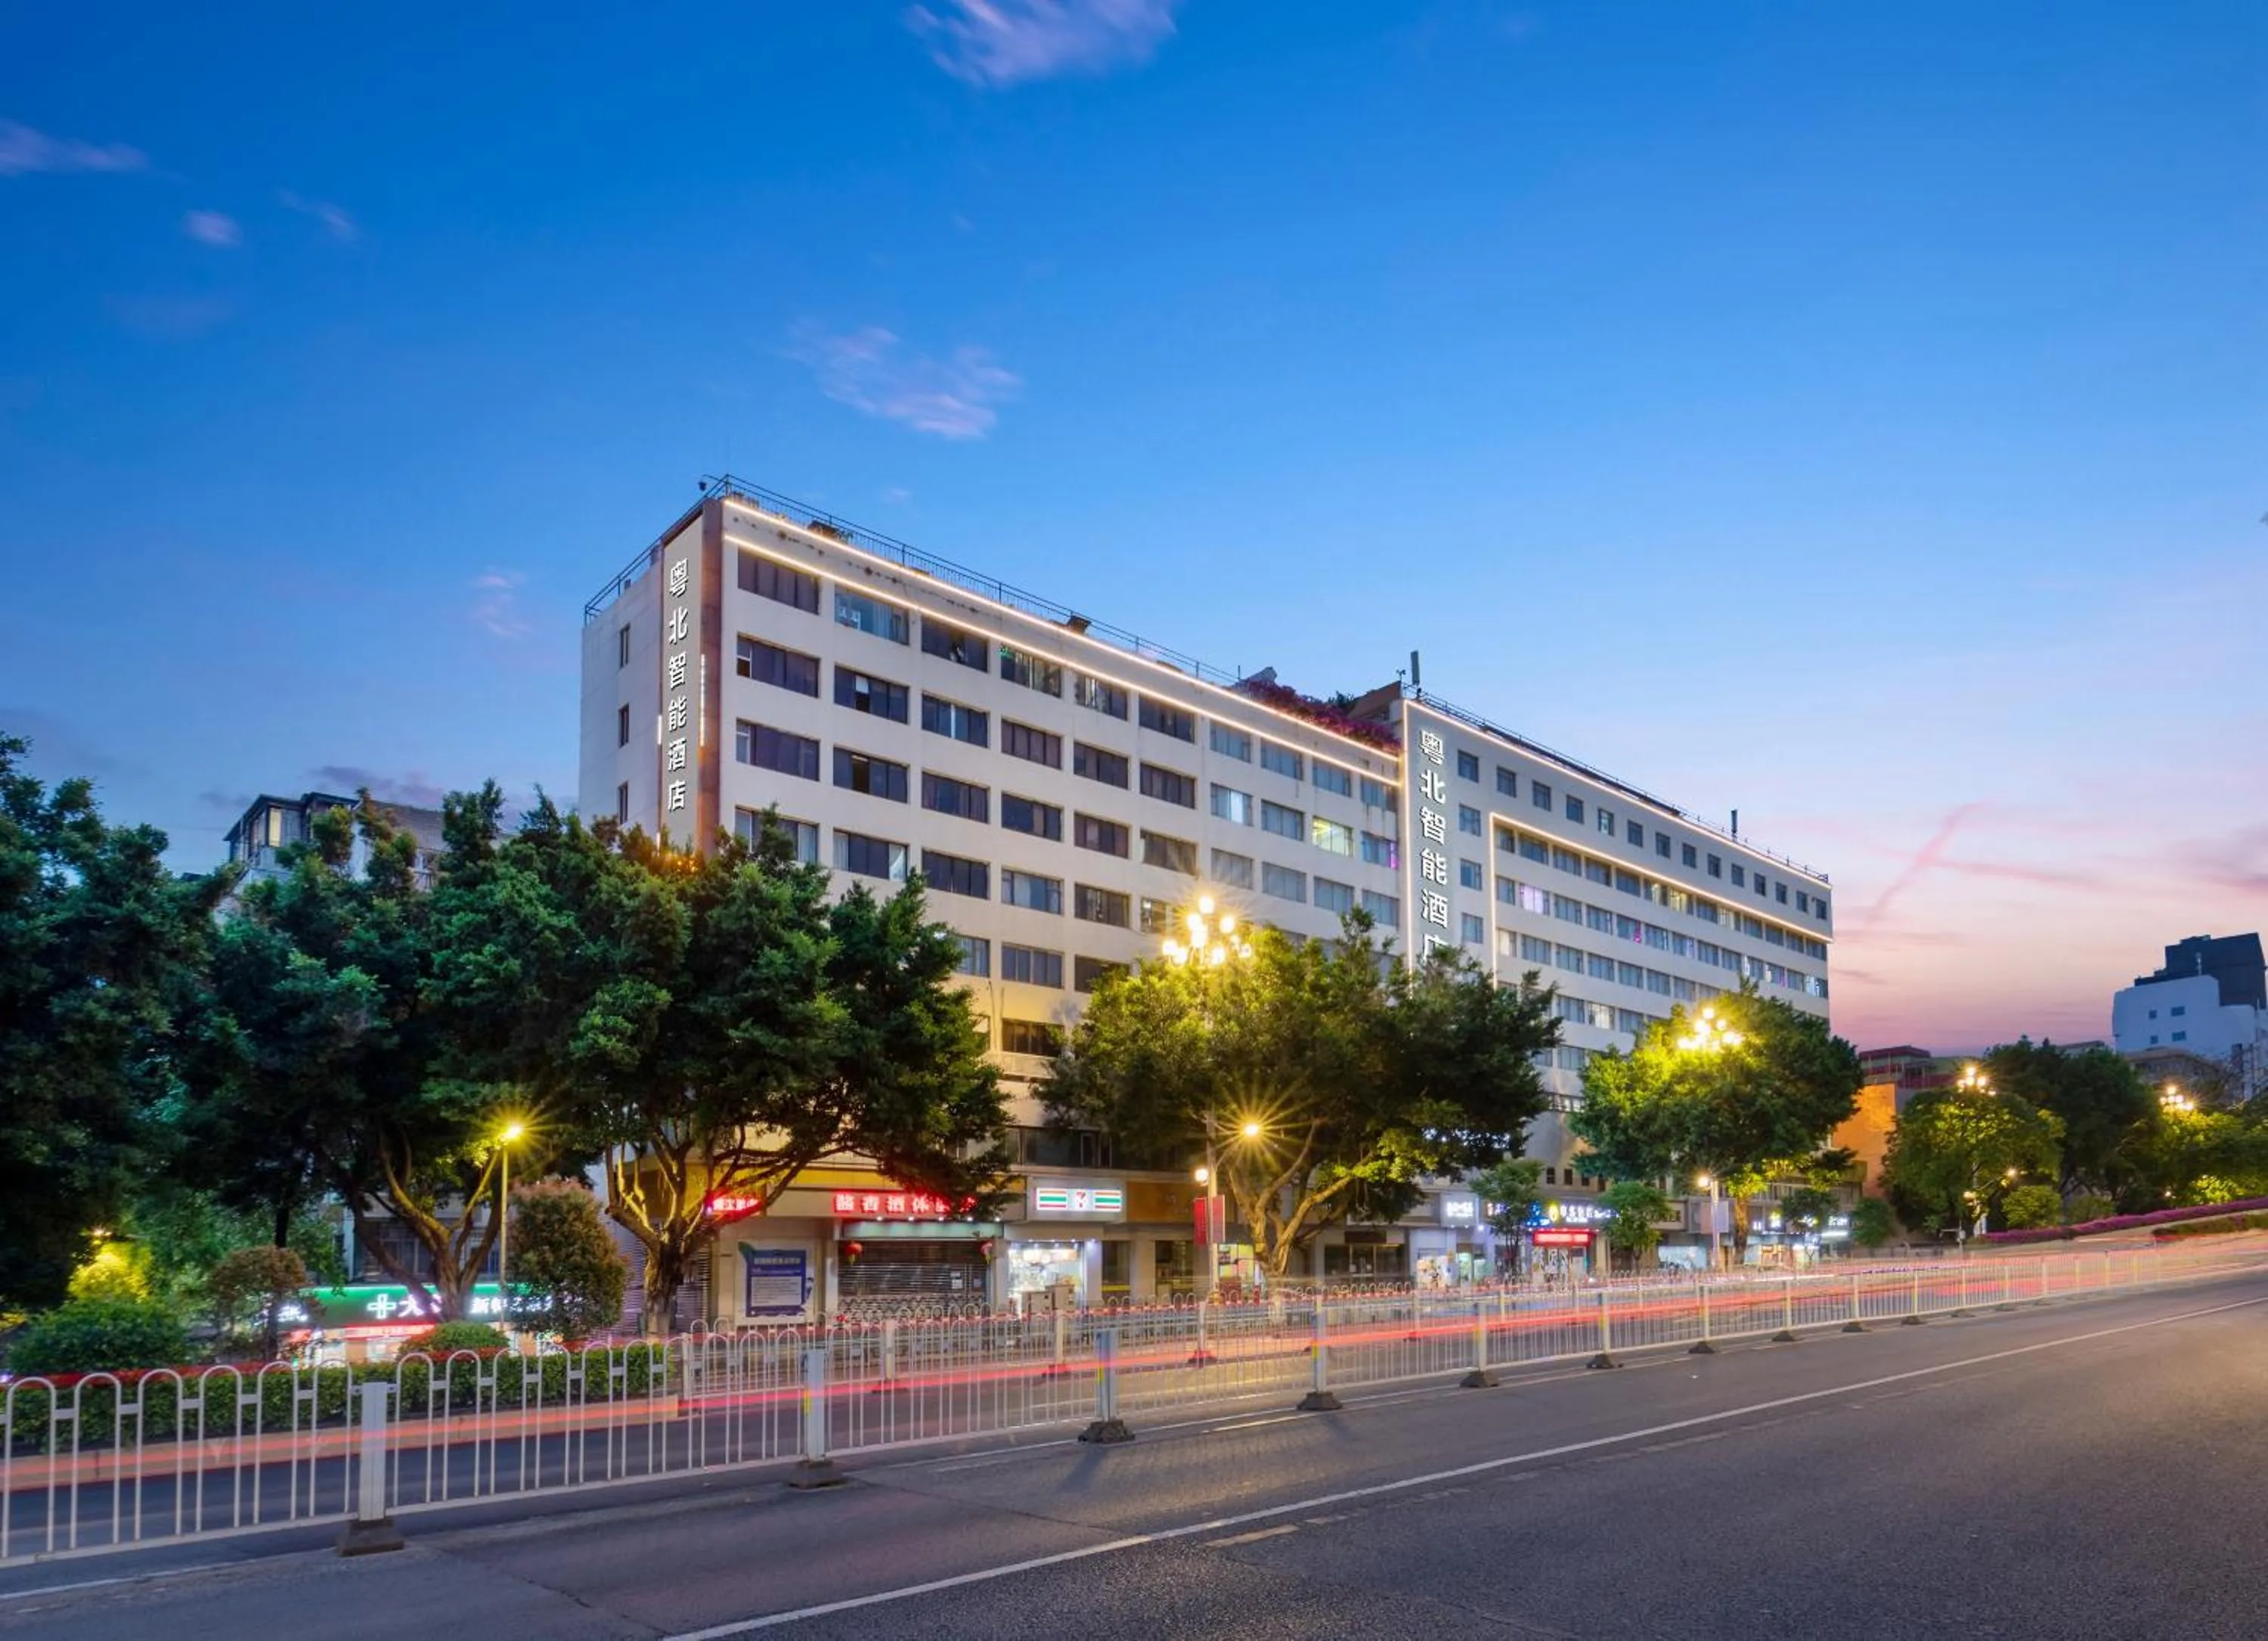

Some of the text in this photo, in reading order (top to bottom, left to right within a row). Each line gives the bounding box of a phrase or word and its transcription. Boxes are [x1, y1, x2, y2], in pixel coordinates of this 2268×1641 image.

[668, 558, 689, 811] 粤北智能酒店
